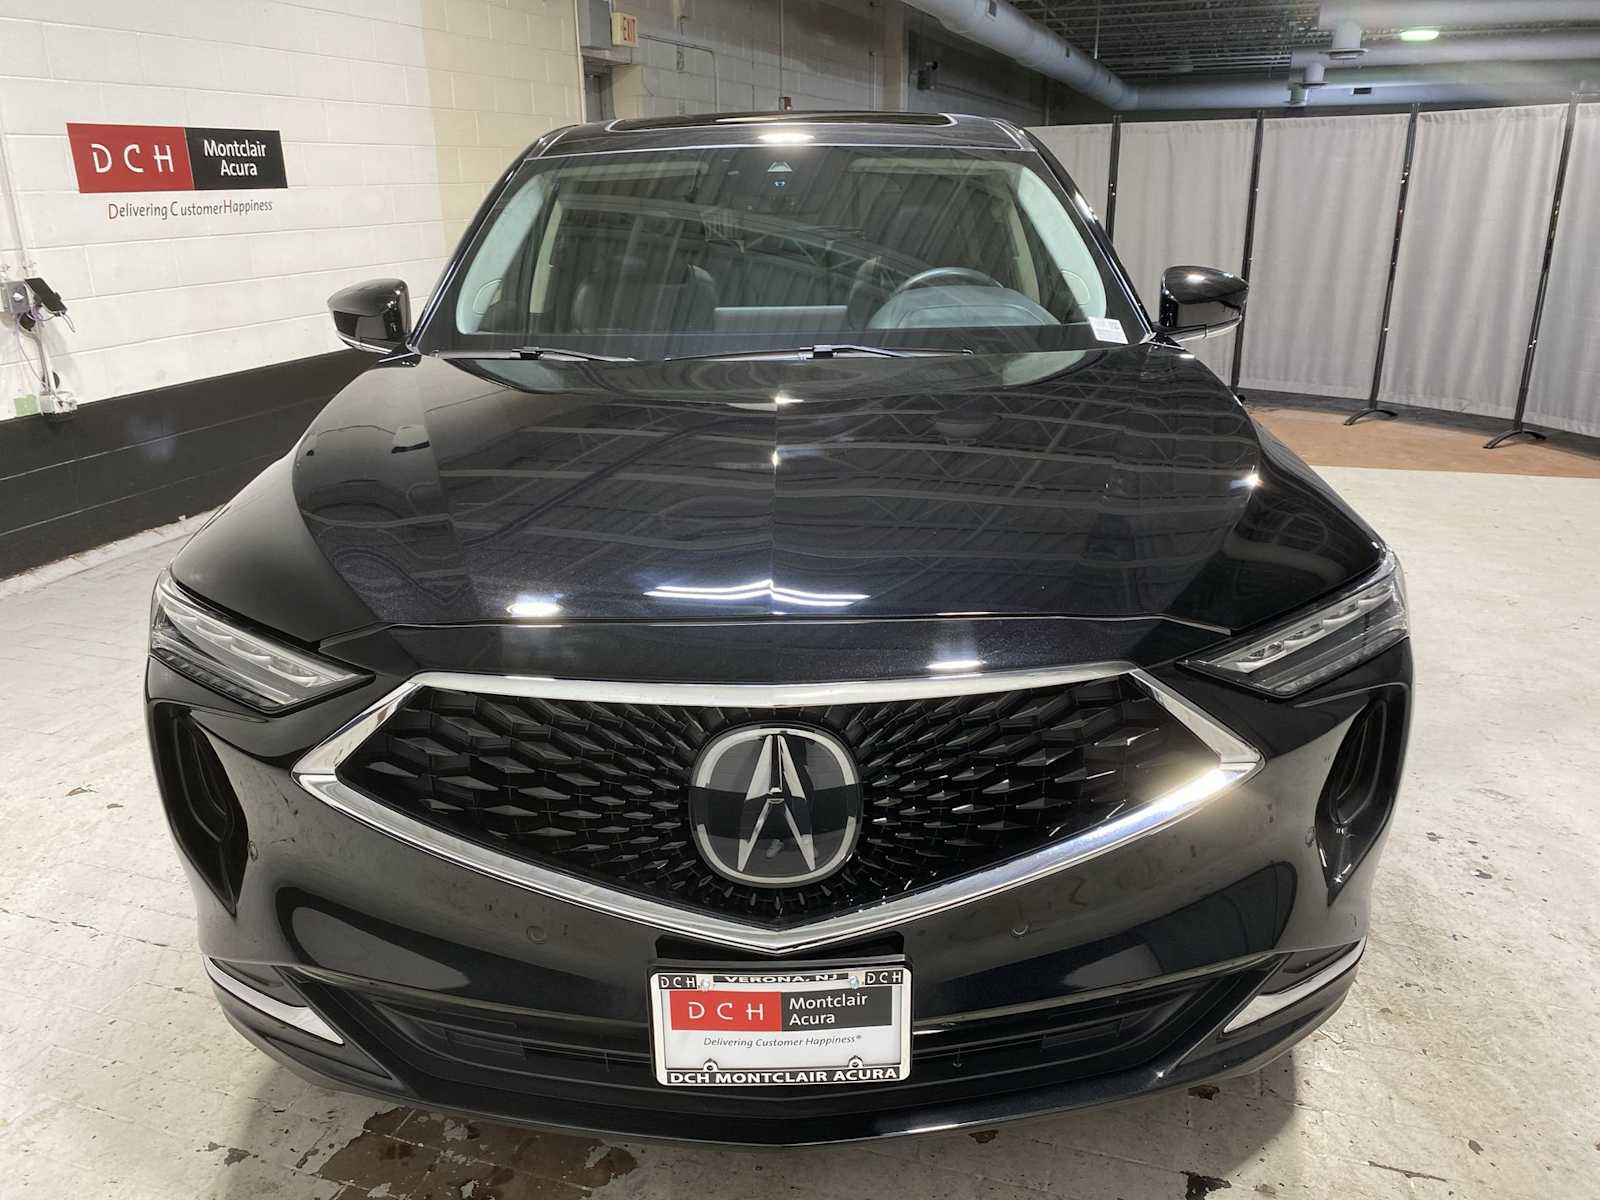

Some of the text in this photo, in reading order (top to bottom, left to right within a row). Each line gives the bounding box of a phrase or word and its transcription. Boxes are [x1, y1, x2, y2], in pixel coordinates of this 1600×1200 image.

[623, 16, 636, 42] EXIT
[203, 139, 267, 157] Montclair
[220, 159, 258, 176] Acura
[108, 203, 168, 220] Delivering
[789, 992, 868, 1010] Montclair
[789, 1013, 835, 1026] Acura
[703, 1037, 753, 1048] Delivering
[755, 1038, 803, 1047] Customer
[670, 1067, 898, 1084] DCH MONTCLAIR ACURA
